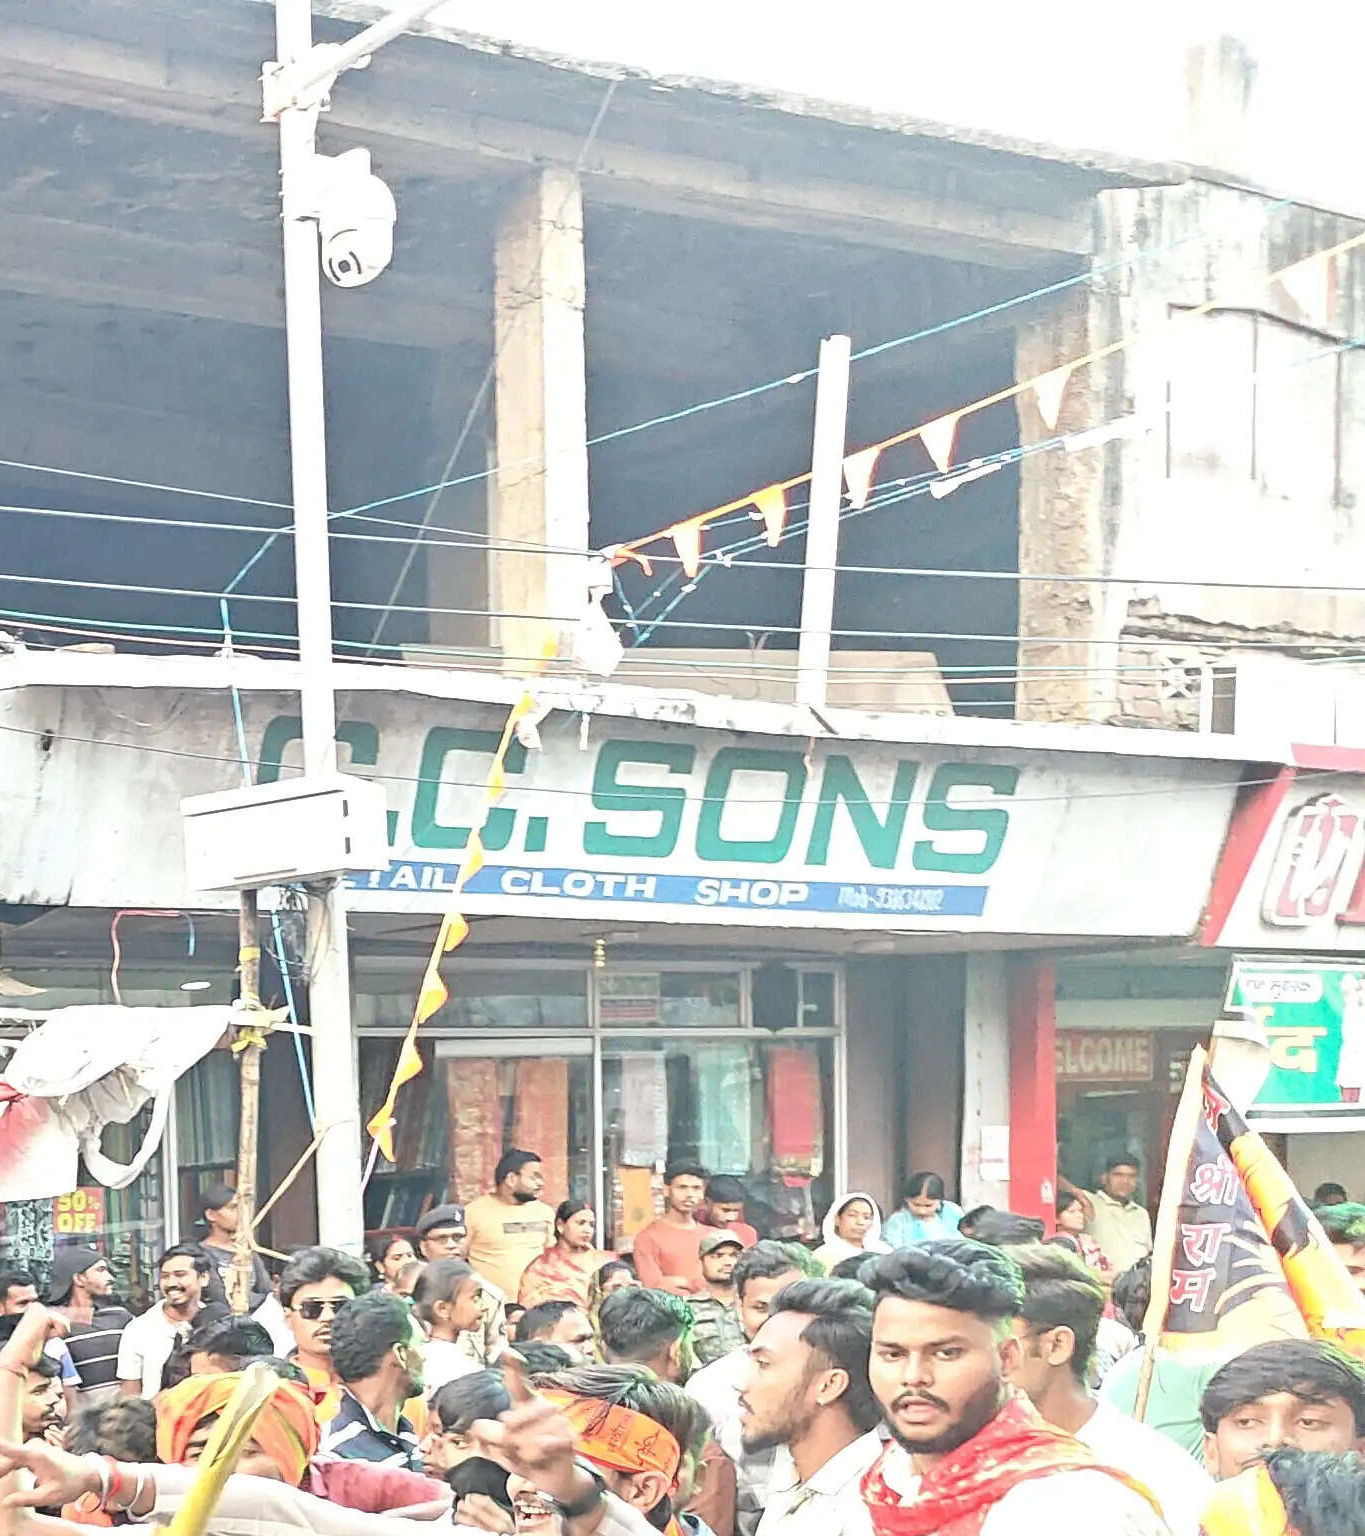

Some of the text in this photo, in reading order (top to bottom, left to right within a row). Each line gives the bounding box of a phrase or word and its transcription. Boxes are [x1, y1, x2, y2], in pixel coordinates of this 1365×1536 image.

[582, 738, 1021, 876] SONS
[499, 869, 658, 900] CLOTH
[694, 878, 810, 907] SHOP
[1056, 1035, 1150, 1073] ELCOME
[57, 1212, 97, 1233] OFF
